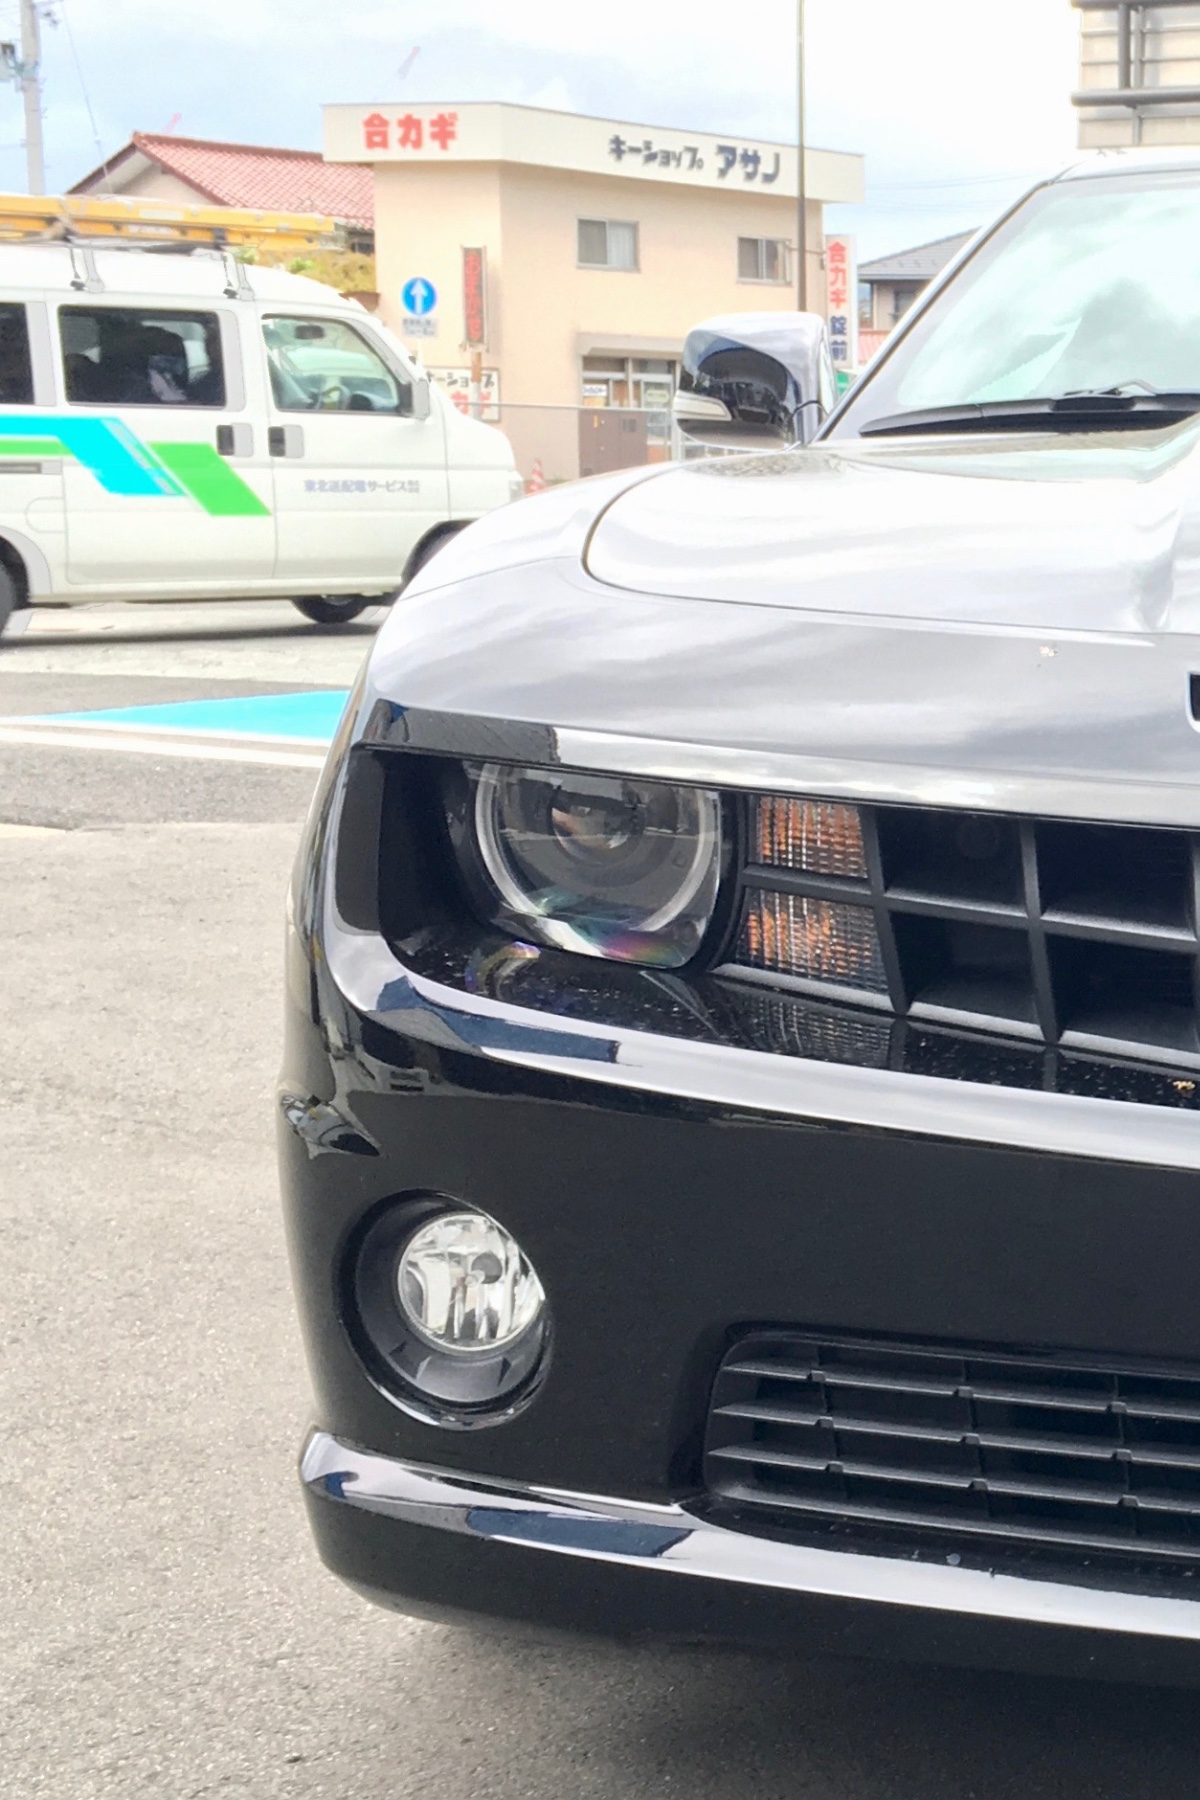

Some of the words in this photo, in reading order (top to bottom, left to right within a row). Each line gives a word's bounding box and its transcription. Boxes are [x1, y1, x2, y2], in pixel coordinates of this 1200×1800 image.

[363, 112, 458, 151] 合カギ
[609, 134, 704, 171] キーショップ
[716, 144, 781, 184] アサノ
